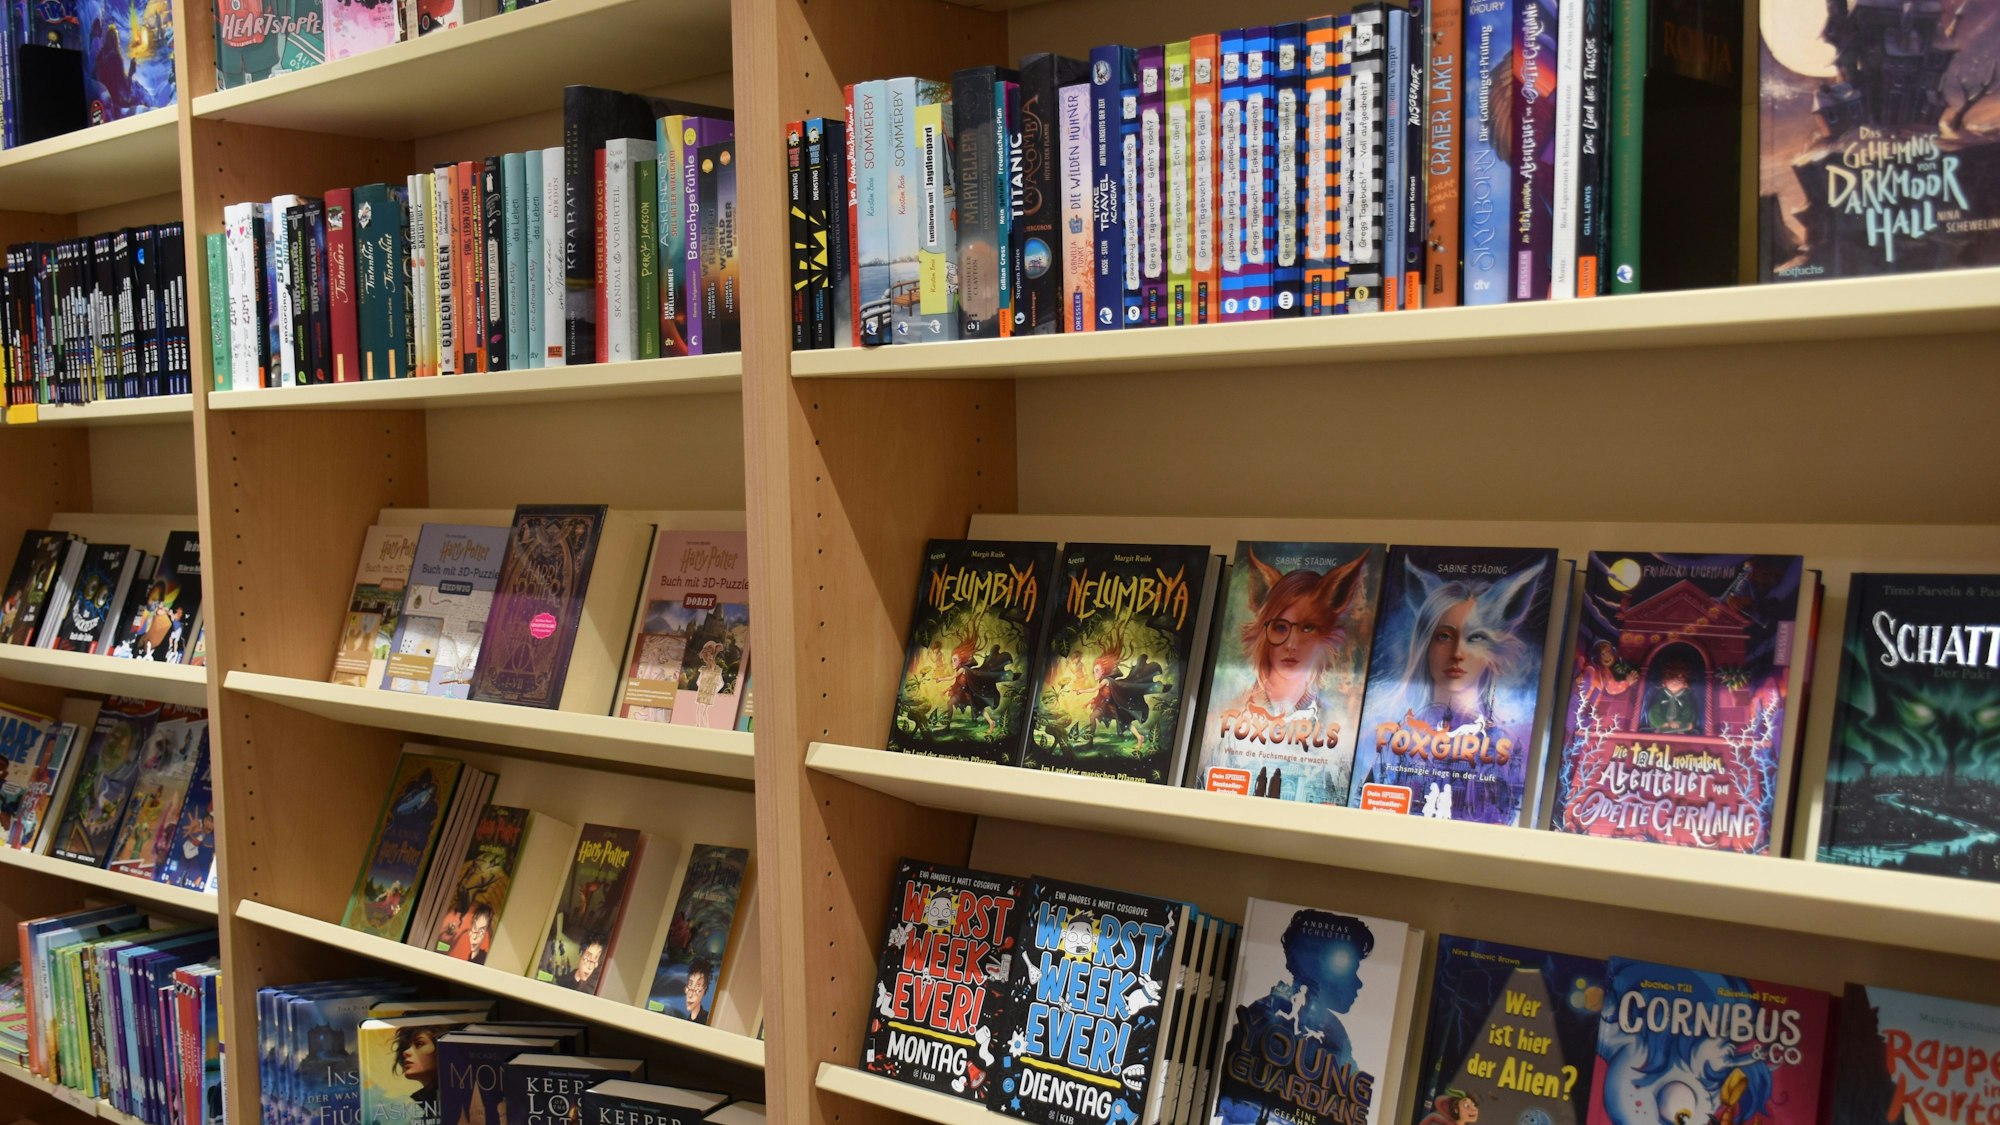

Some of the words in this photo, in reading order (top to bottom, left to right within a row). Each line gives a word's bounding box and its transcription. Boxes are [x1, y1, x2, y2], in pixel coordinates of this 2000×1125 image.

[222, 12, 324, 39] HEARTSTOPPE
[1469, 2, 1504, 16] KHOURY
[1478, 26, 1492, 122] Goldflügel-Prüfung
[1583, 38, 1597, 80] Flusses
[1431, 54, 1453, 102] LAKE
[1584, 85, 1595, 102] des
[1066, 95, 1080, 141] HÜHNER
[1281, 96, 1290, 141] Probleme?
[1359, 82, 1367, 137] aufgedreht!
[1583, 106, 1598, 129] Lied
[864, 94, 874, 169] SOMMERBY
[893, 91, 905, 167] SOMMERBY
[1430, 110, 1453, 176] CRATER
[1478, 124, 1489, 142] Die
[1583, 134, 1595, 155] Das
[925, 127, 935, 186] Jagdleopard
[1359, 139, 1367, 157] Voll
[1842, 134, 1939, 168] GEHEIMNIS
[1010, 133, 1023, 220] TITANIC
[1068, 145, 1081, 189] WILDEN
[1917, 161, 1937, 172] von
[596, 179, 604, 221] QUACH
[658, 152, 669, 247] ASKENDOR
[1070, 192, 1081, 209] DIE
[1101, 173, 1109, 231] TRAVEL
[1110, 179, 1118, 224] ACADEMY
[1408, 176, 1416, 201] Knösel
[1584, 186, 1592, 214] LEWIS
[1826, 156, 1968, 214] DARKMOOR
[511, 199, 520, 225] Leben
[532, 196, 540, 222] Leben
[641, 202, 650, 239] JACKSON
[686, 155, 699, 260] Bauchgefühle
[1470, 148, 1496, 272] SKYBORN
[1937, 210, 1961, 221] NINA
[512, 226, 520, 242] das
[532, 224, 540, 240] das
[567, 182, 577, 270] KRABAT
[724, 202, 733, 258] RUNNER
[1359, 221, 1367, 248] Gregs
[1583, 216, 1591, 236] GILL
[1866, 201, 1937, 262] HALL
[275, 235, 284, 283] SOUL
[378, 233, 396, 293] Tintenblut
[641, 242, 652, 277] PERCY
[1282, 233, 1291, 260] Gregs
[335, 243, 348, 304] Tintenherz
[439, 245, 450, 290] GREEN
[1474, 279, 1490, 290] dtv
[1519, 253, 1530, 297] DRESSLER
[440, 294, 452, 348] GIDEON
[1075, 294, 1083, 330] DRESSLER
[422, 564, 442, 575] Buch
[444, 565, 456, 576] mit
[458, 566, 500, 579] 3D-Puzzle
[972, 550, 988, 558] Margit
[990, 551, 1005, 559] Ruile
[1067, 556, 1085, 565] Arena
[1114, 554, 1135, 563] Margit
[1135, 555, 1152, 563] Ruile
[1275, 557, 1302, 566] SABINE
[1305, 557, 1337, 567] STÄDING
[1438, 563, 1467, 574] SABINE
[1471, 566, 1508, 576] STÄDING
[440, 582, 471, 592] HEDWIG
[661, 575, 682, 587] Buch
[685, 576, 700, 587] mit
[702, 577, 749, 589] 3D-Puzzle
[928, 561, 1038, 622] NELUMBIYA
[1067, 564, 1189, 630] NELUMBIYA
[686, 596, 715, 606] DOBBY
[1776, 623, 1789, 664] DRESSLER
[1934, 668, 1957, 678] Der
[1962, 668, 1991, 679] Pakt
[1220, 710, 1341, 752] FOXGIRLS
[1375, 721, 1512, 766] FOXGIRLS
[1224, 748, 1244, 758] Wenn
[1246, 750, 1257, 758] die
[1258, 750, 1298, 763] Fuchsmagie
[1300, 755, 1328, 765] erwacht
[1386, 763, 1429, 777] Fuchsmagie
[1431, 768, 1449, 779] liegt
[1452, 771, 1460, 779] in
[1462, 772, 1477, 781] der
[1479, 772, 1496, 782] Luft
[1598, 761, 1714, 797] Abenteuer
[1713, 783, 1729, 795] von
[1572, 791, 1650, 829] ODETTE
[1652, 798, 1755, 847] GERMAINE
[578, 840, 603, 864] Harry
[600, 840, 629, 868] Potter
[919, 870, 930, 879] EVA
[930, 872, 951, 882] AMORES
[957, 877, 971, 886] MATT
[974, 879, 1001, 891] COSGROVE
[1055, 891, 1066, 900] EVA
[1067, 894, 1091, 905] AMORES
[1092, 897, 1096, 905] &
[1098, 899, 1116, 909] MATT
[1117, 902, 1148, 917] COSGROVE
[1302, 928, 1352, 942] SCHLÜTER
[1303, 920, 1349, 933] ANDREAS
[902, 930, 990, 985] WEEK
[892, 972, 986, 1035] EVER!
[1036, 952, 1137, 1021] WEEK
[1640, 979, 1674, 990] Jochen
[1677, 981, 1692, 993] Till
[1505, 990, 1541, 1019] Wer
[1618, 990, 1801, 1046] CORNIBUS
[886, 1031, 968, 1076] MONTAG
[1025, 1003, 1131, 1075] EVER!
[1489, 1023, 1513, 1048] ist
[1516, 1026, 1552, 1056] hier
[1752, 1044, 1765, 1060] &
[1769, 1043, 1802, 1064] CO
[921, 1071, 936, 1081] KJB
[1235, 1012, 1374, 1107] YOUNG
[1467, 1054, 1496, 1080] der
[1497, 1056, 1578, 1100] Alien?
[1018, 1068, 1112, 1119] DIENSTAG
[1228, 1050, 1369, 1125] GUARDIANS
[1059, 1114, 1074, 1125] KJB
[1296, 1108, 1316, 1124] EINE
